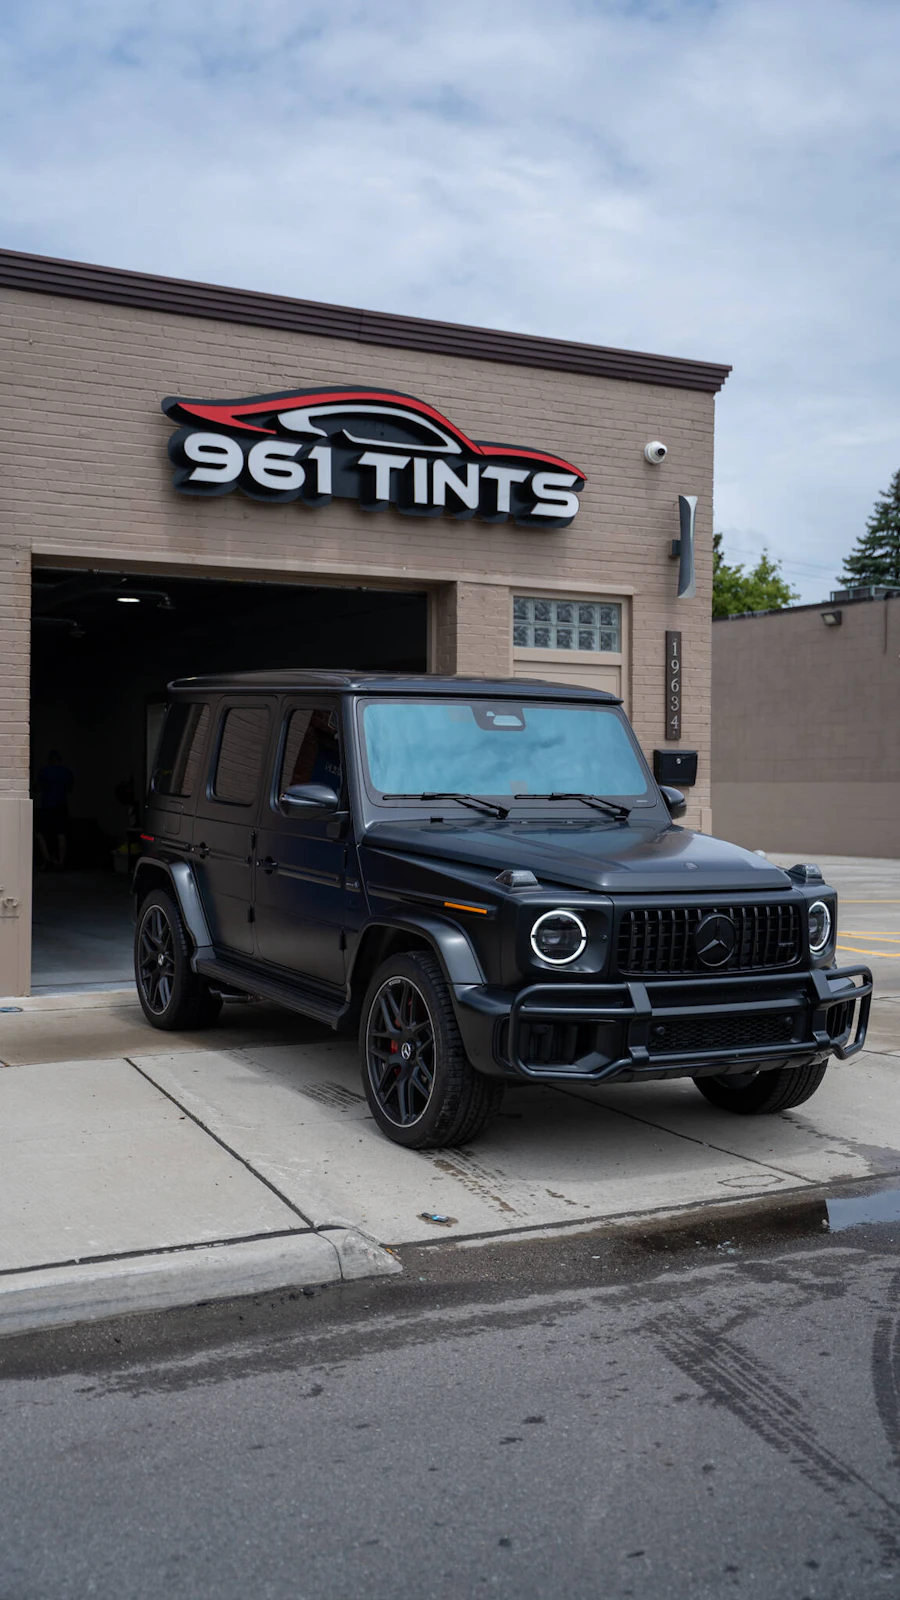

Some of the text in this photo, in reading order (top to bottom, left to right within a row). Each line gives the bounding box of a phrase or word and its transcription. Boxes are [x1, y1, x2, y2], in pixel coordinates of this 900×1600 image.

[183, 432, 580, 518] 961 TINTS
[670, 641, 680, 730] 19634
